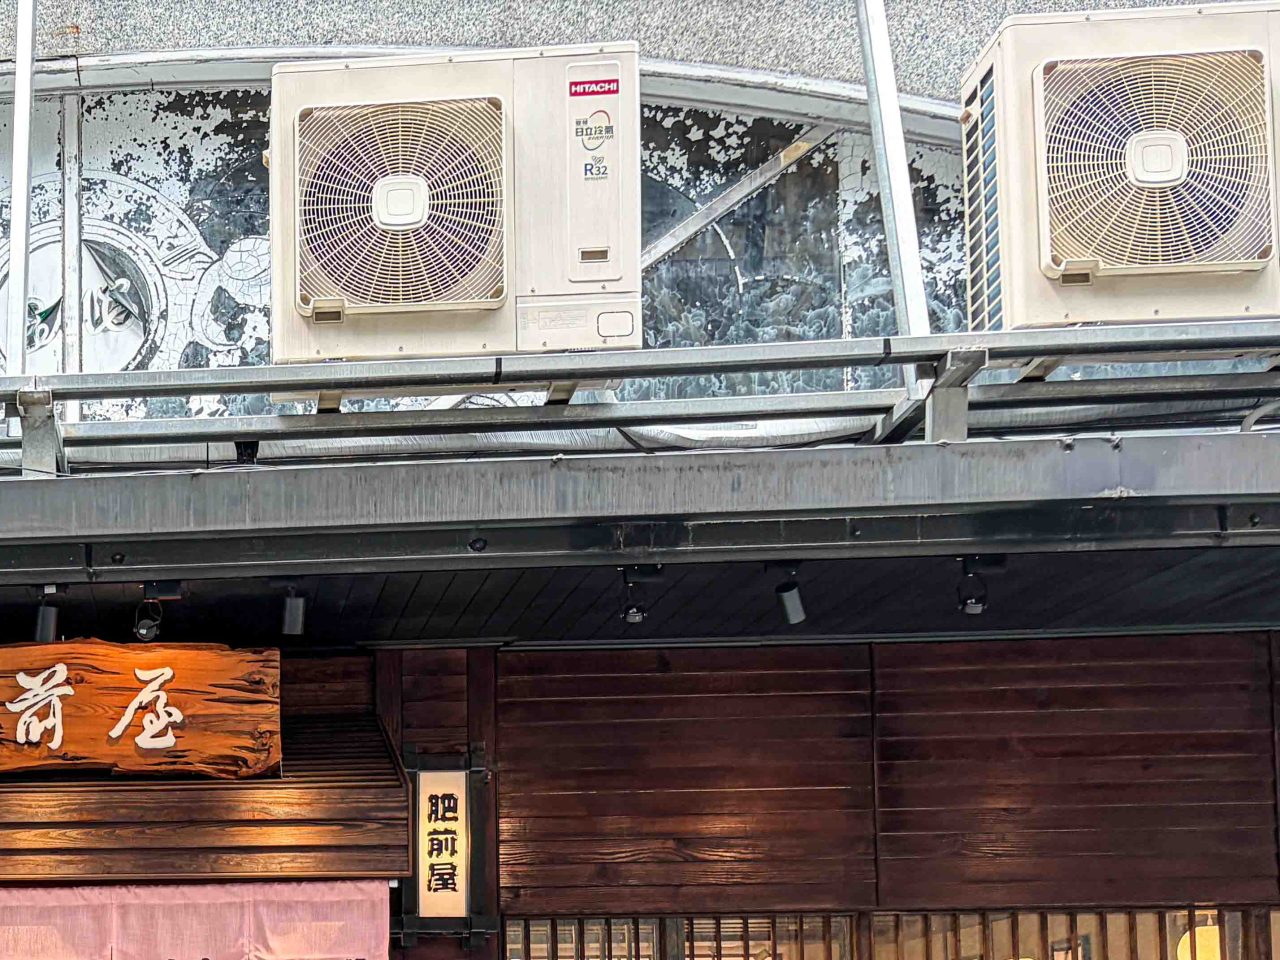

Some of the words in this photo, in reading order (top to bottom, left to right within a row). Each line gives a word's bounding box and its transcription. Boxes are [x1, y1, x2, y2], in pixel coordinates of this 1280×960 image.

[571, 82, 618, 94] HITACHI
[575, 126, 614, 137] 日立冷氣
[584, 163, 608, 176] R32
[427, 792, 459, 893] 肥前屋
